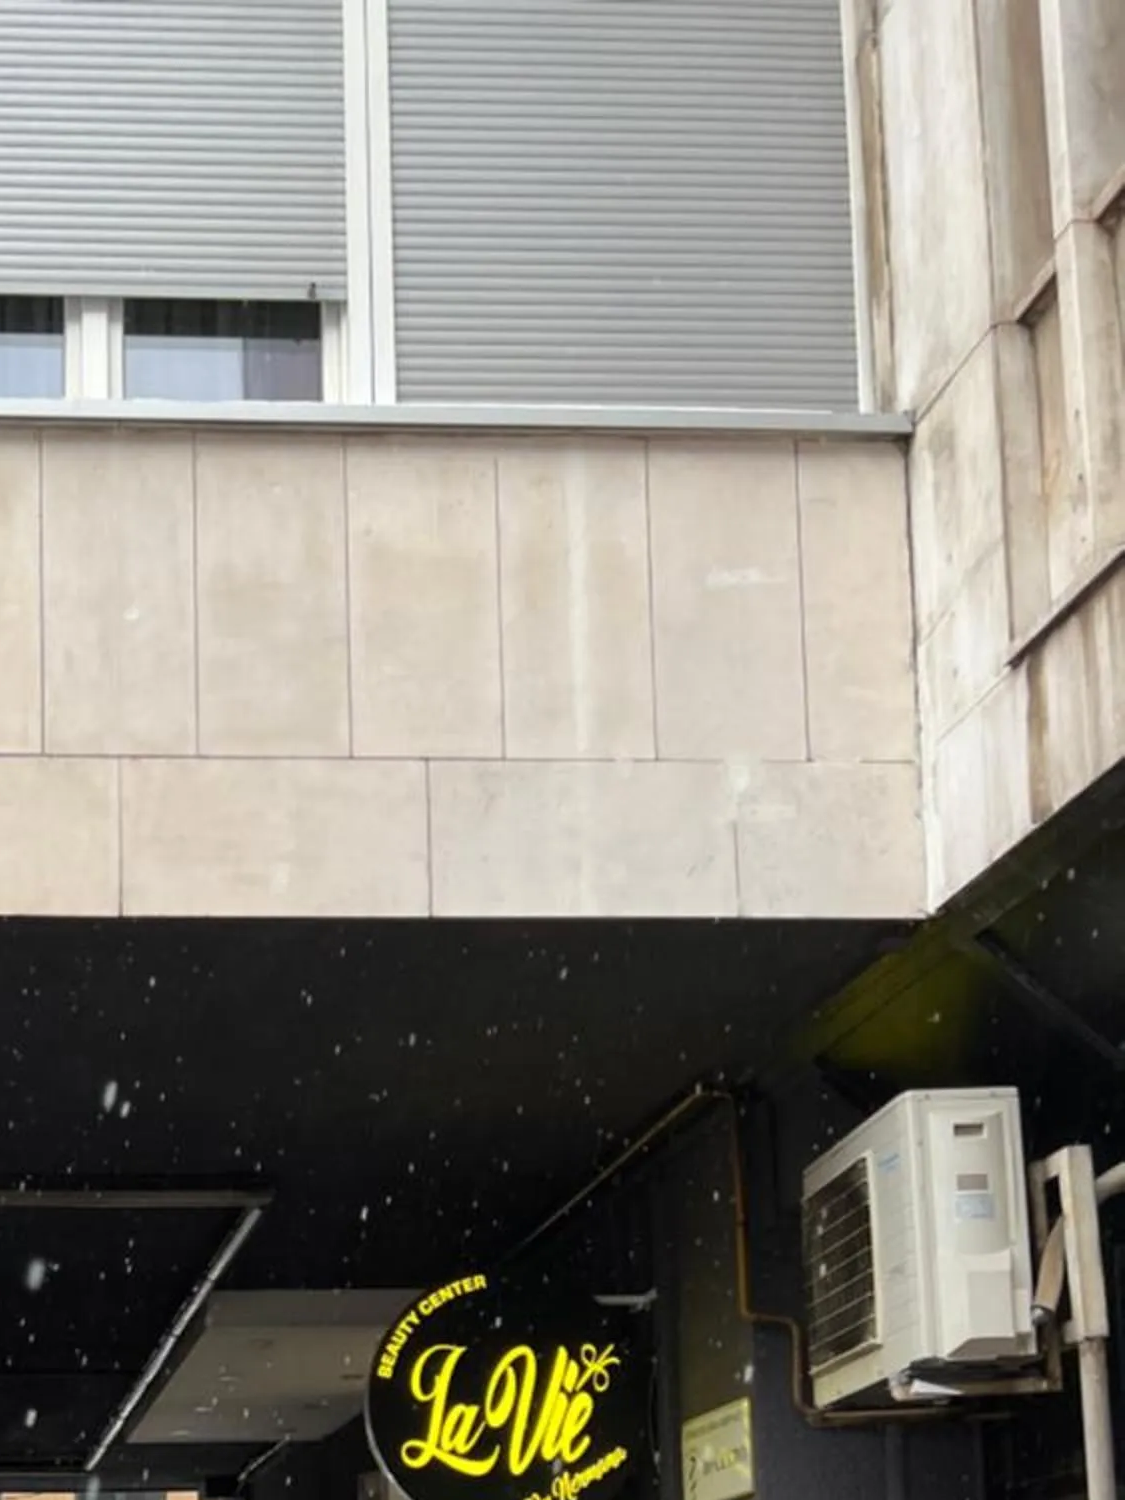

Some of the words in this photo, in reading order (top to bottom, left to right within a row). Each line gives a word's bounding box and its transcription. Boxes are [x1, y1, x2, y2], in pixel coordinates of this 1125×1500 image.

[377, 1310, 420, 1379] BEAUTY
[417, 1274, 487, 1315] CENTER
[401, 1344, 501, 1476] La
[485, 1344, 594, 1476] Vie
